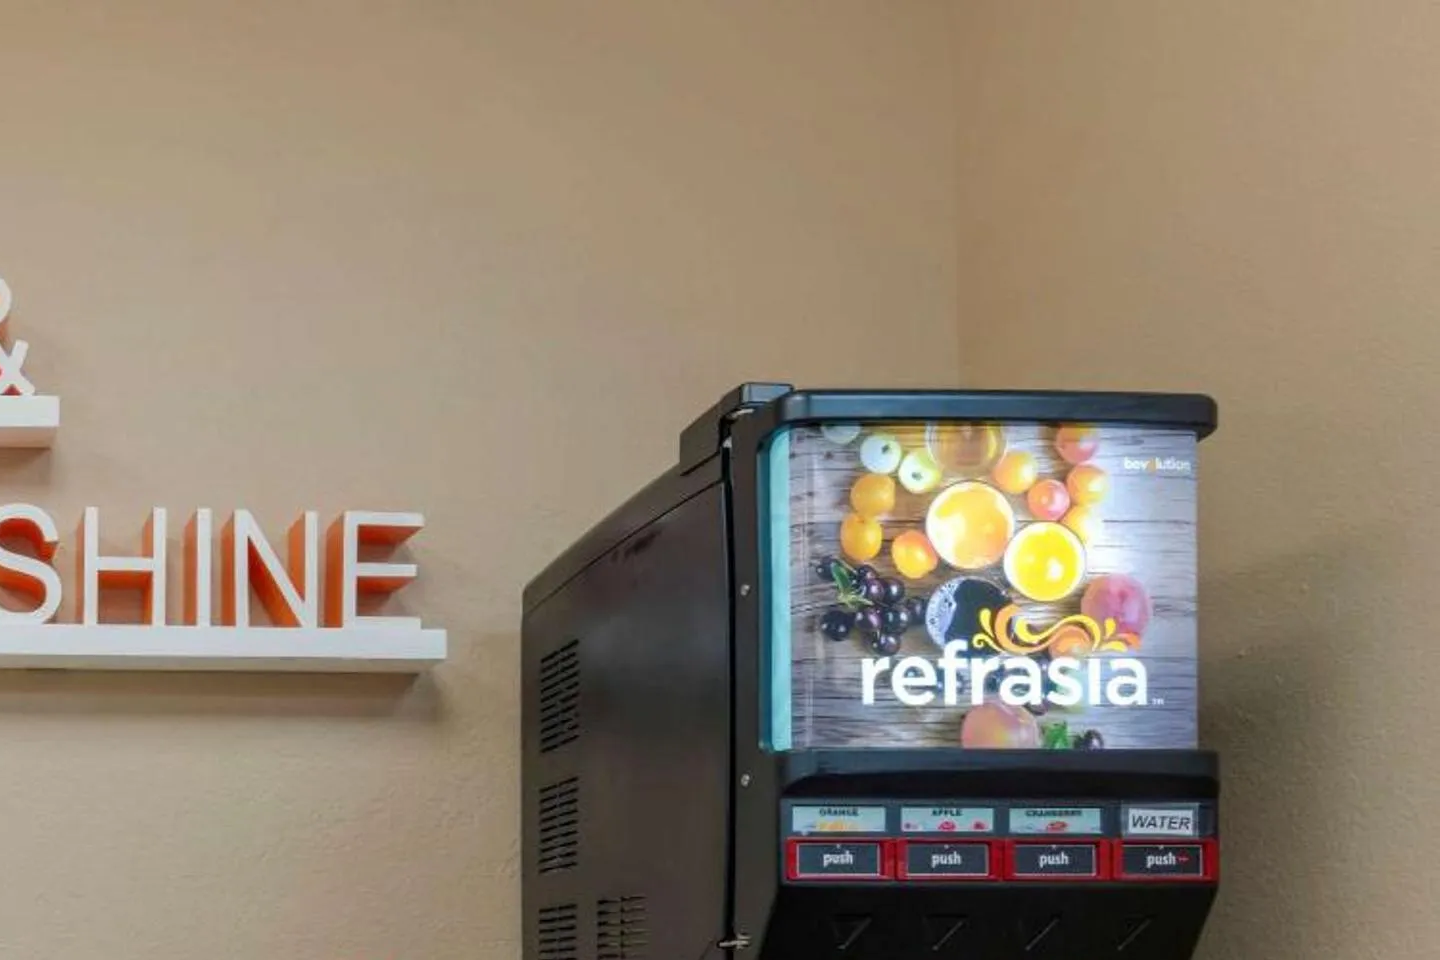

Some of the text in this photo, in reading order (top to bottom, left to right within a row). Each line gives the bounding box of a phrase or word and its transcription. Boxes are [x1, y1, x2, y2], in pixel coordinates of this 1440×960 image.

[860, 639, 1148, 706] refrasia
[818, 806, 860, 817] ORANGE
[931, 807, 963, 817] APPLE
[1024, 809, 1083, 818] CRANBERRY
[1131, 814, 1191, 831] WATER
[822, 849, 854, 867] push
[931, 850, 963, 867] push
[1038, 850, 1070, 867] push
[1145, 851, 1177, 869] push
